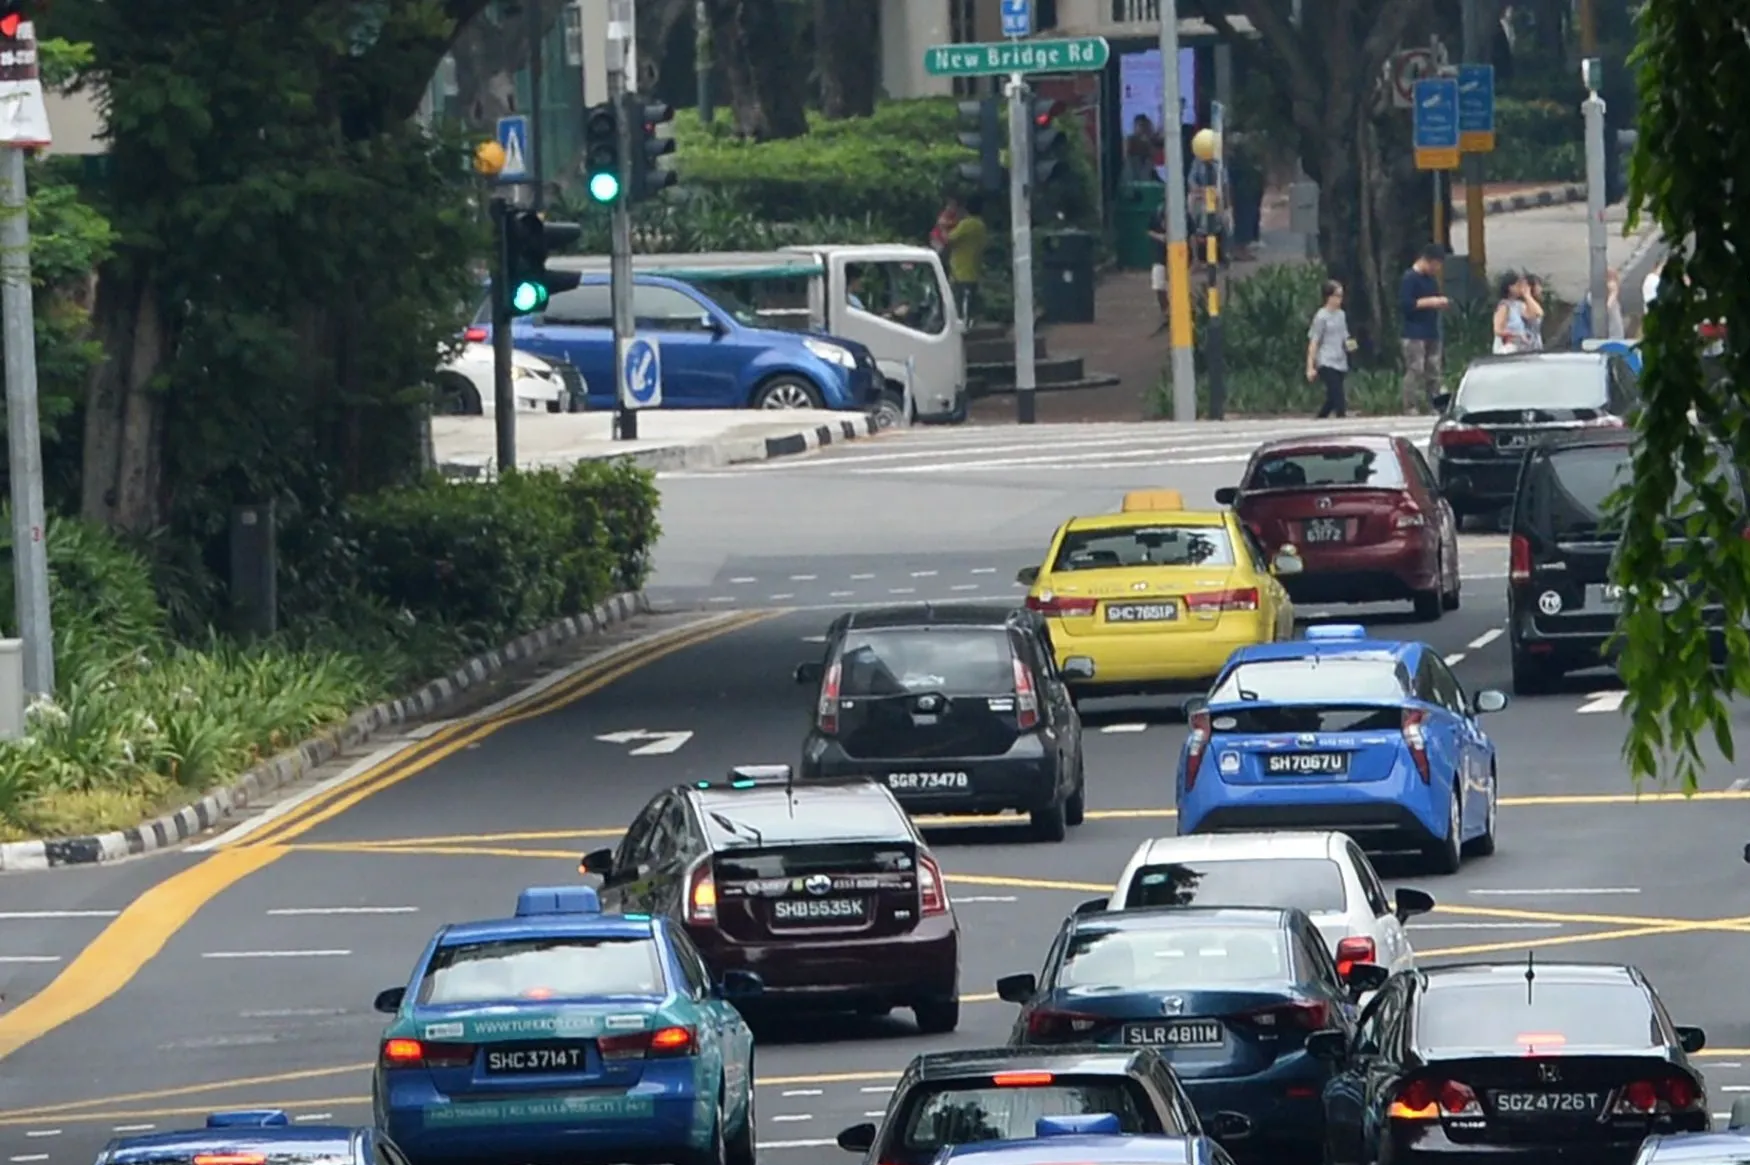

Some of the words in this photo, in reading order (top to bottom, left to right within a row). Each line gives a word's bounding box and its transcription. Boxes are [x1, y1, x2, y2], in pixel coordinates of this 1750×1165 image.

[935, 50, 979, 69] New
[988, 47, 1058, 68] Bridge
[1068, 44, 1094, 62] Rd
[1108, 602, 1174, 621] SHC7651P
[1269, 754, 1342, 771] SH7067U
[775, 900, 863, 918] SHB5535K
[1130, 1025, 1218, 1044] SLR4811M
[489, 1050, 581, 1070] SHC3714T
[1497, 1093, 1599, 1112] SGZ4726T
